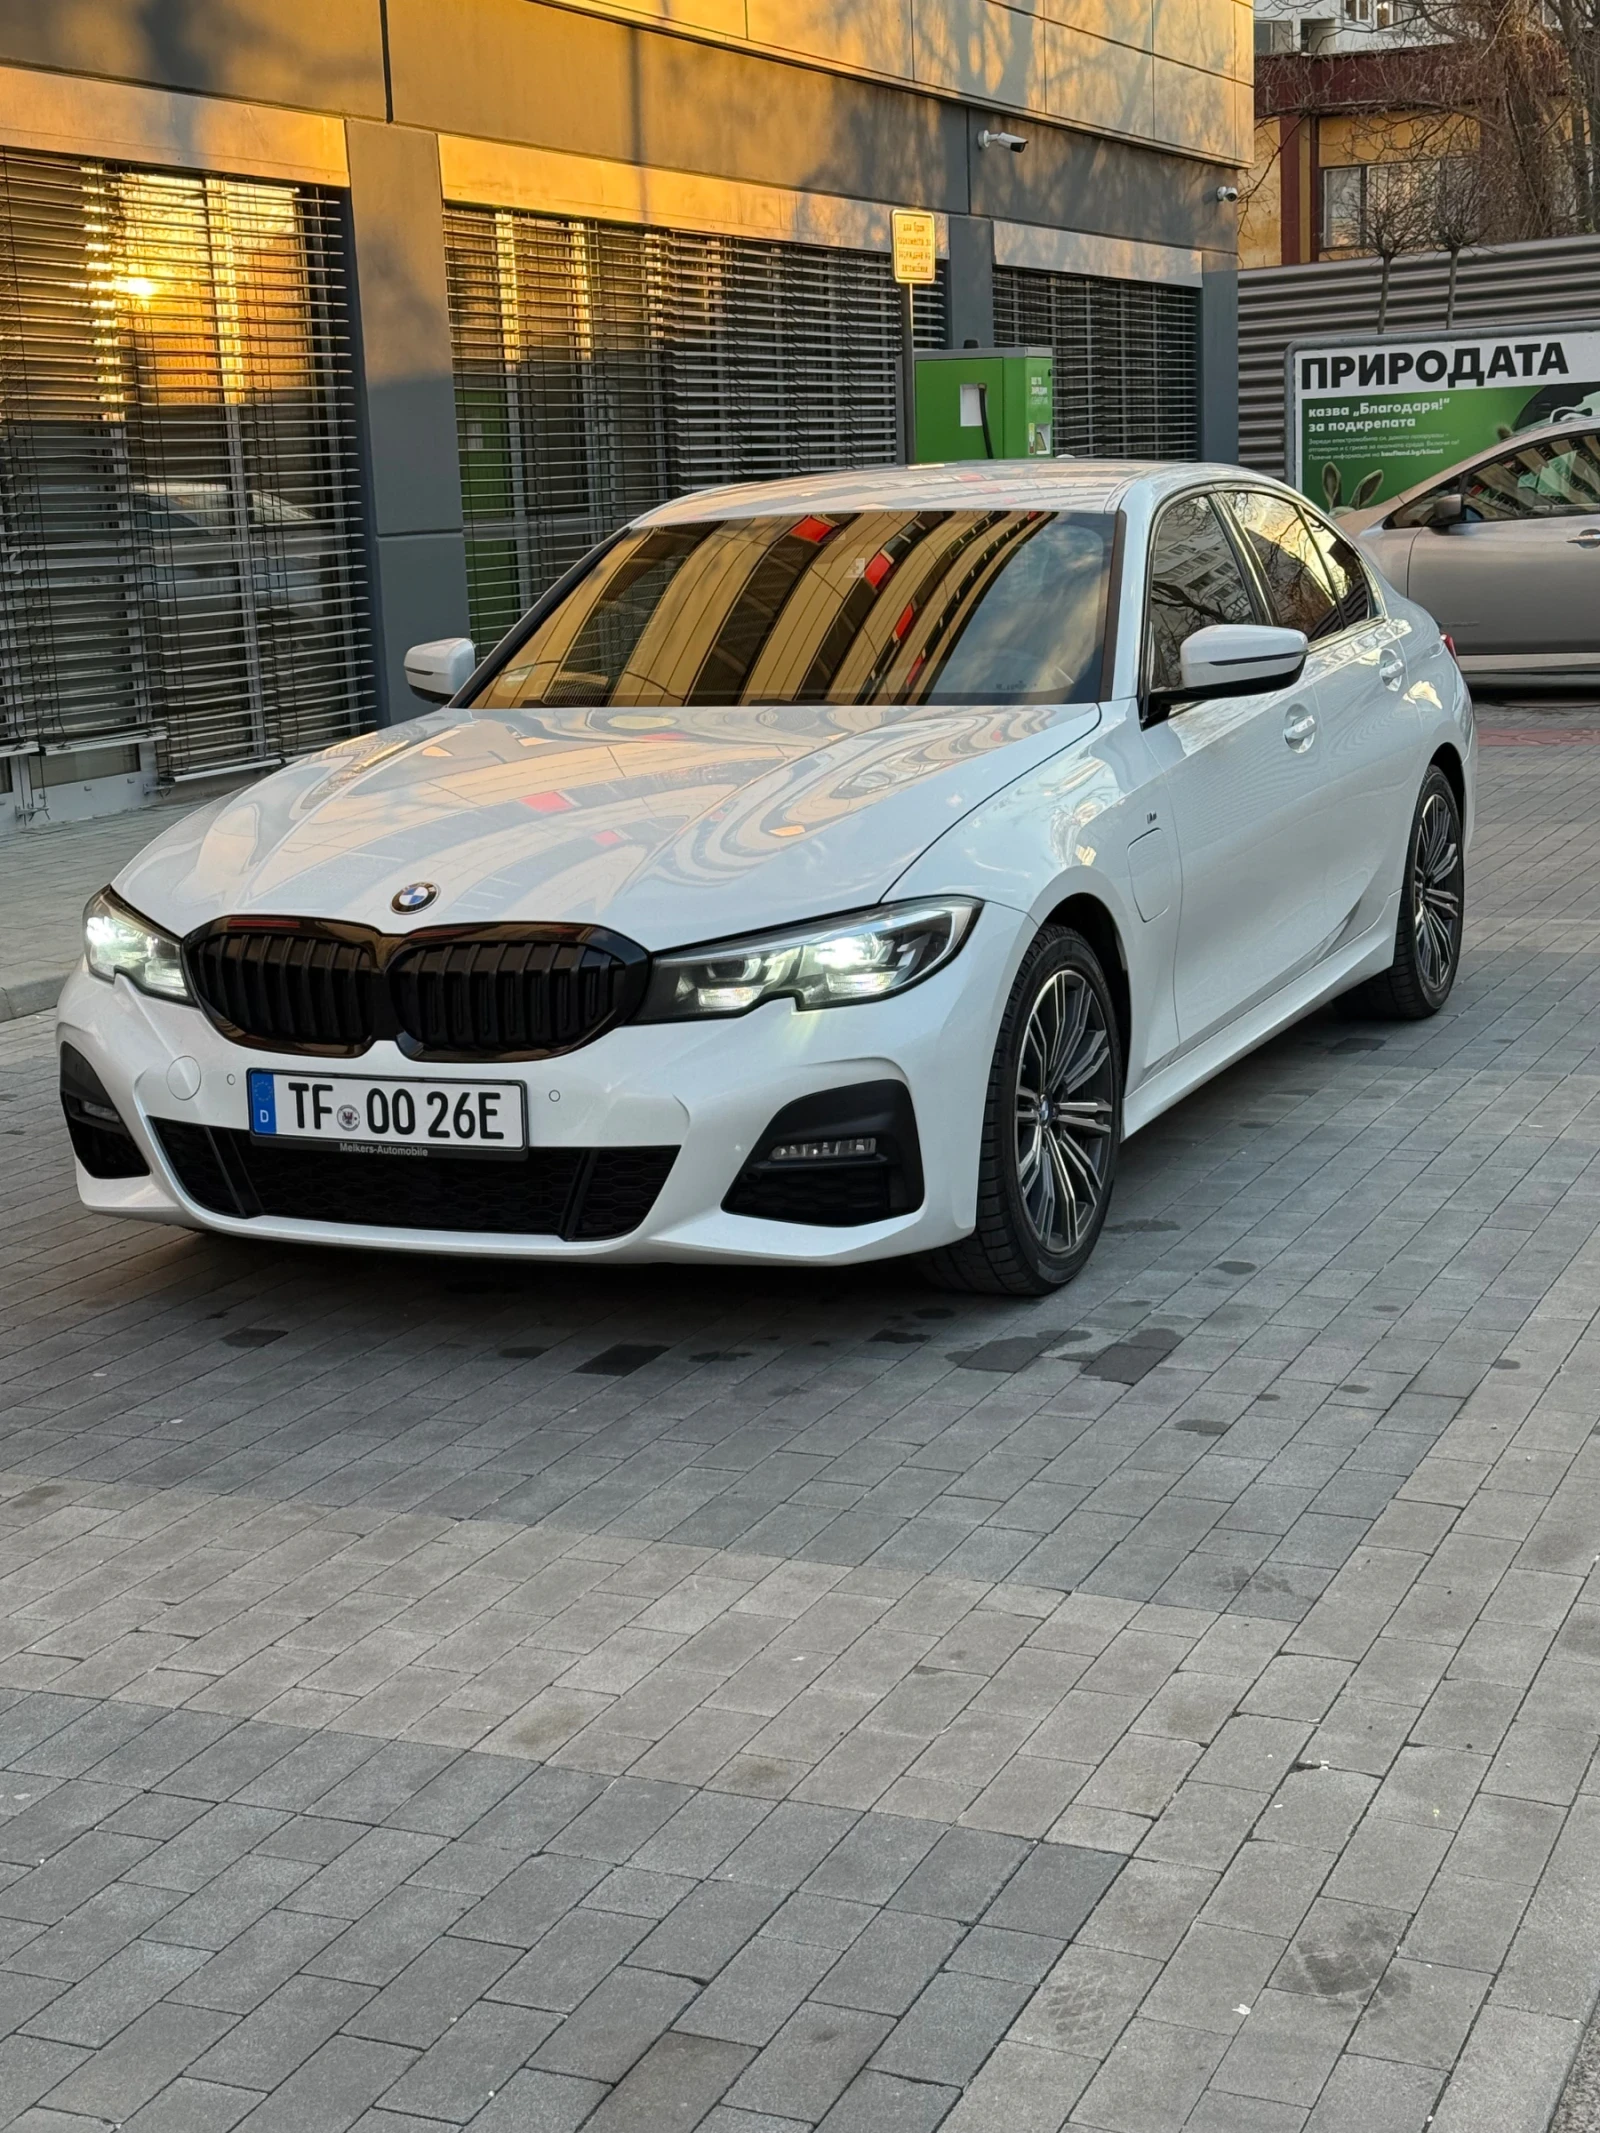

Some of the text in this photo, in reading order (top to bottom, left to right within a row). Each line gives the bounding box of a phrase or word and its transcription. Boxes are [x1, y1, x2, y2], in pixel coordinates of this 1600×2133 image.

[1301, 342, 1569, 390] ПРИРОДАТА
[1308, 405, 1350, 418] казва
[1308, 418, 1416, 432] за подкрепата
[260, 1109, 269, 1123] D
[288, 1082, 334, 1130] TF
[426, 1091, 505, 1140] 26E
[339, 1142, 429, 1157] Melkers-Automobile
